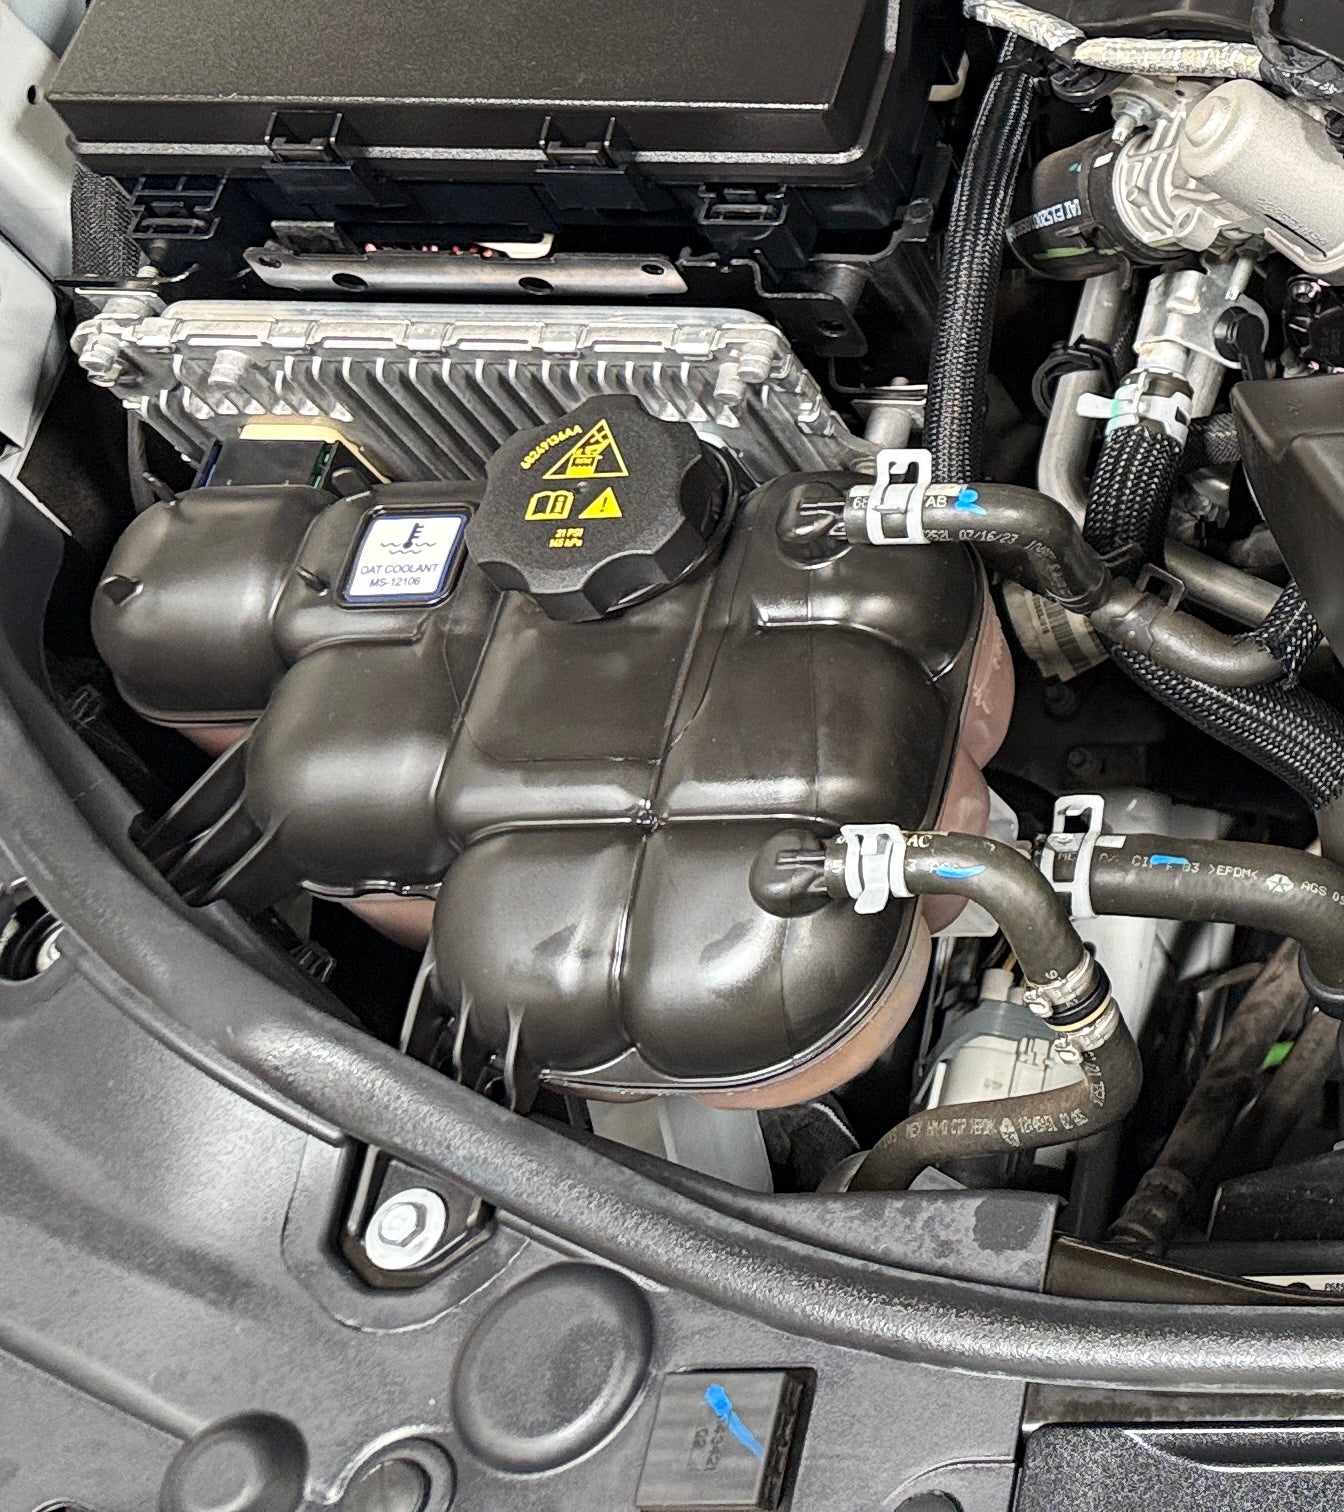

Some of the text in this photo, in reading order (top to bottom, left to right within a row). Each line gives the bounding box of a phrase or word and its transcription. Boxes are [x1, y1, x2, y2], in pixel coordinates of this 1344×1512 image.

[360, 563, 440, 575] OAT COOLANT
[369, 576, 422, 588] MS-12106
[1301, 880, 1327, 897] AGS
